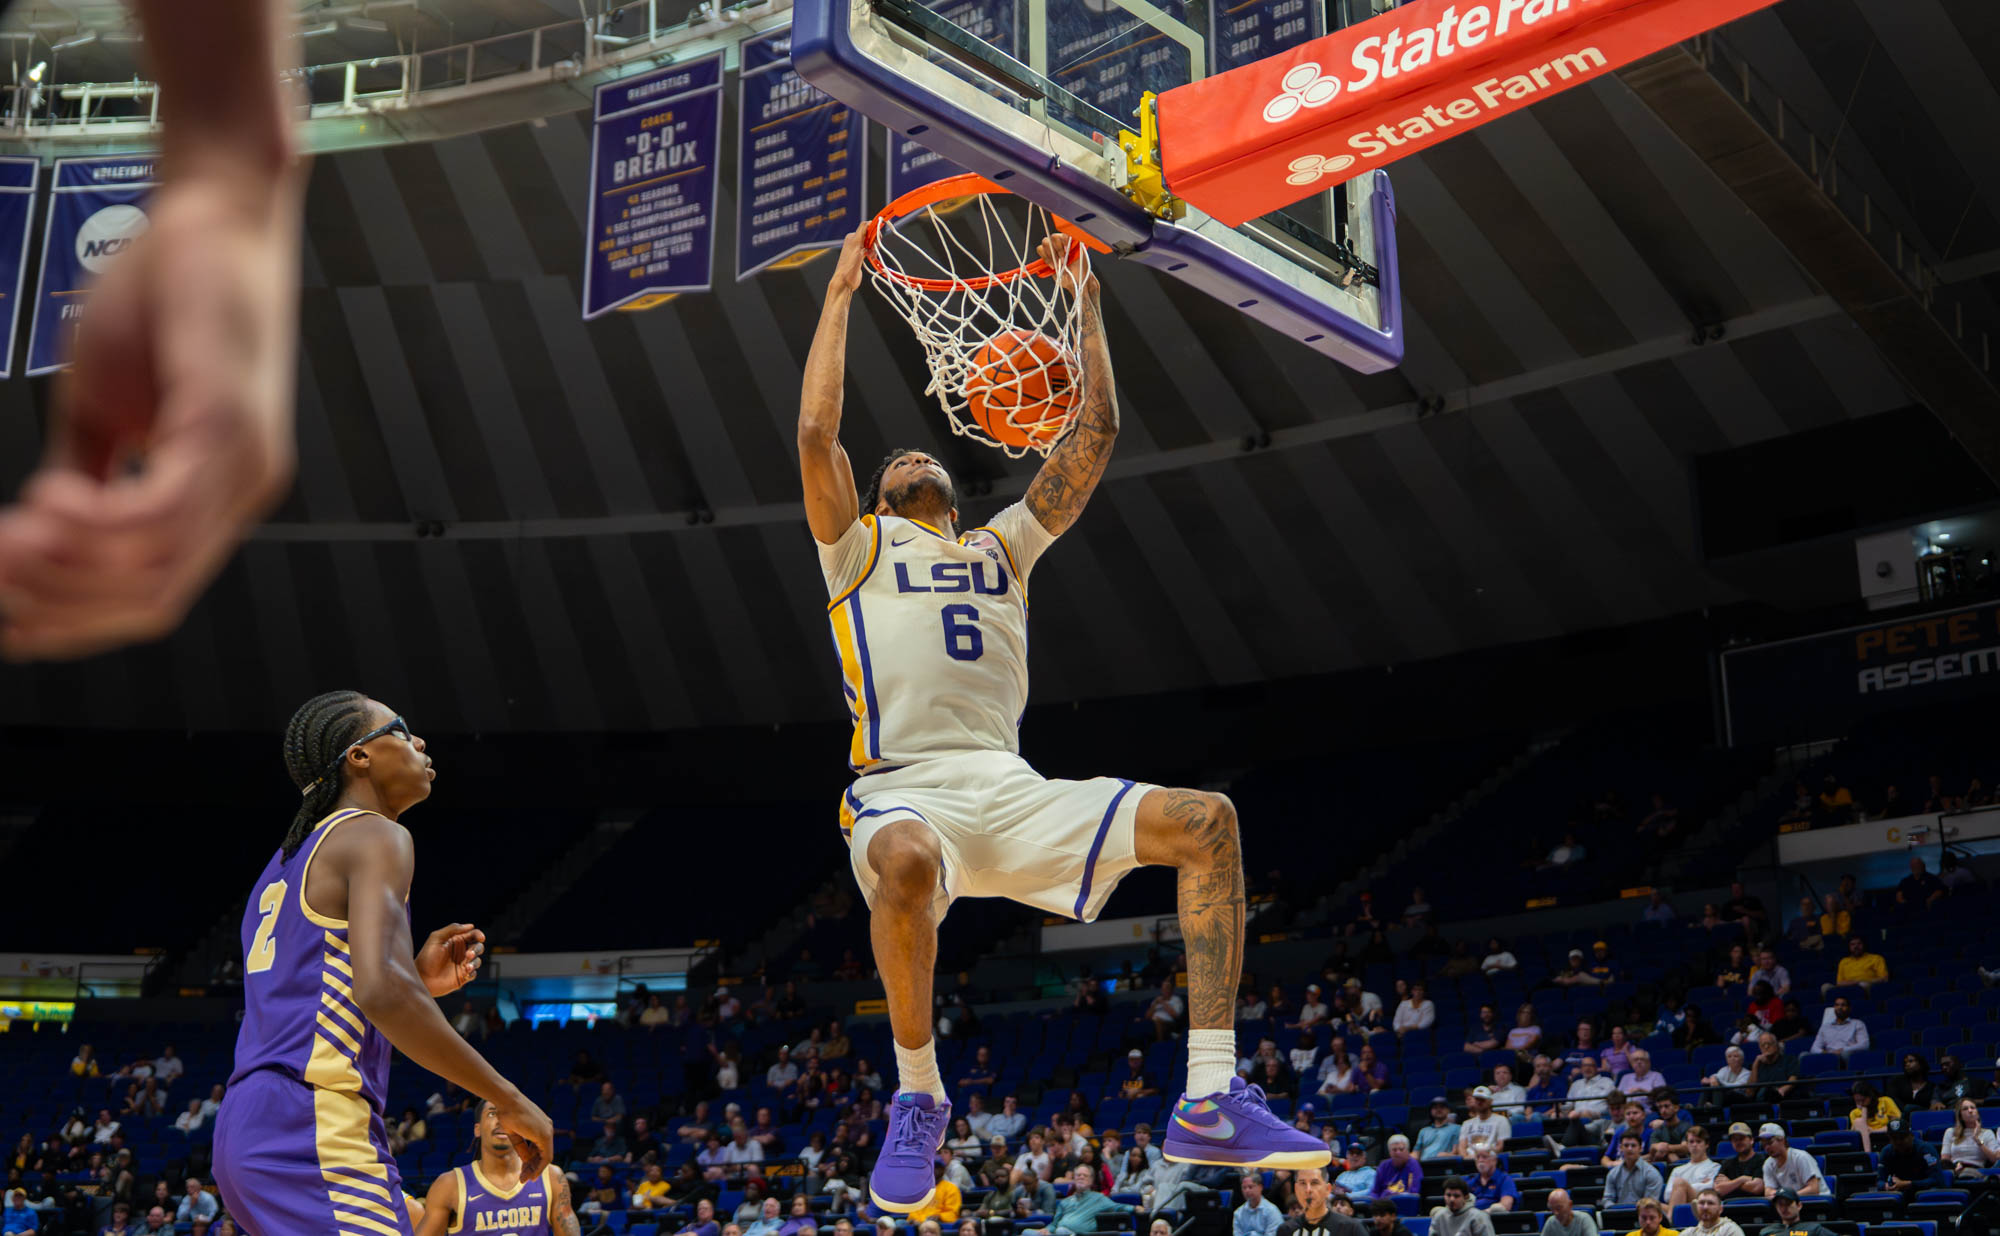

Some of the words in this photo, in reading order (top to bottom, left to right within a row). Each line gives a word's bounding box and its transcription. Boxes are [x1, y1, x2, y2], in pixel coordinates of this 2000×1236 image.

[1231, 34, 1260, 57] 2017
[1347, 5, 1491, 92] State
[627, 73, 690, 101] GYMNASTICS
[1348, 98, 1481, 157] State
[1472, 46, 1608, 109] Farm
[641, 111, 674, 129] COACH
[93, 165, 153, 180] VOLLEYBALL
[614, 140, 698, 182] BREAUX
[894, 561, 1009, 596] LSU
[941, 603, 984, 661] 6
[1856, 611, 1981, 663] PETE
[247, 878, 288, 975] 2
[475, 1205, 542, 1231] ALCORN
